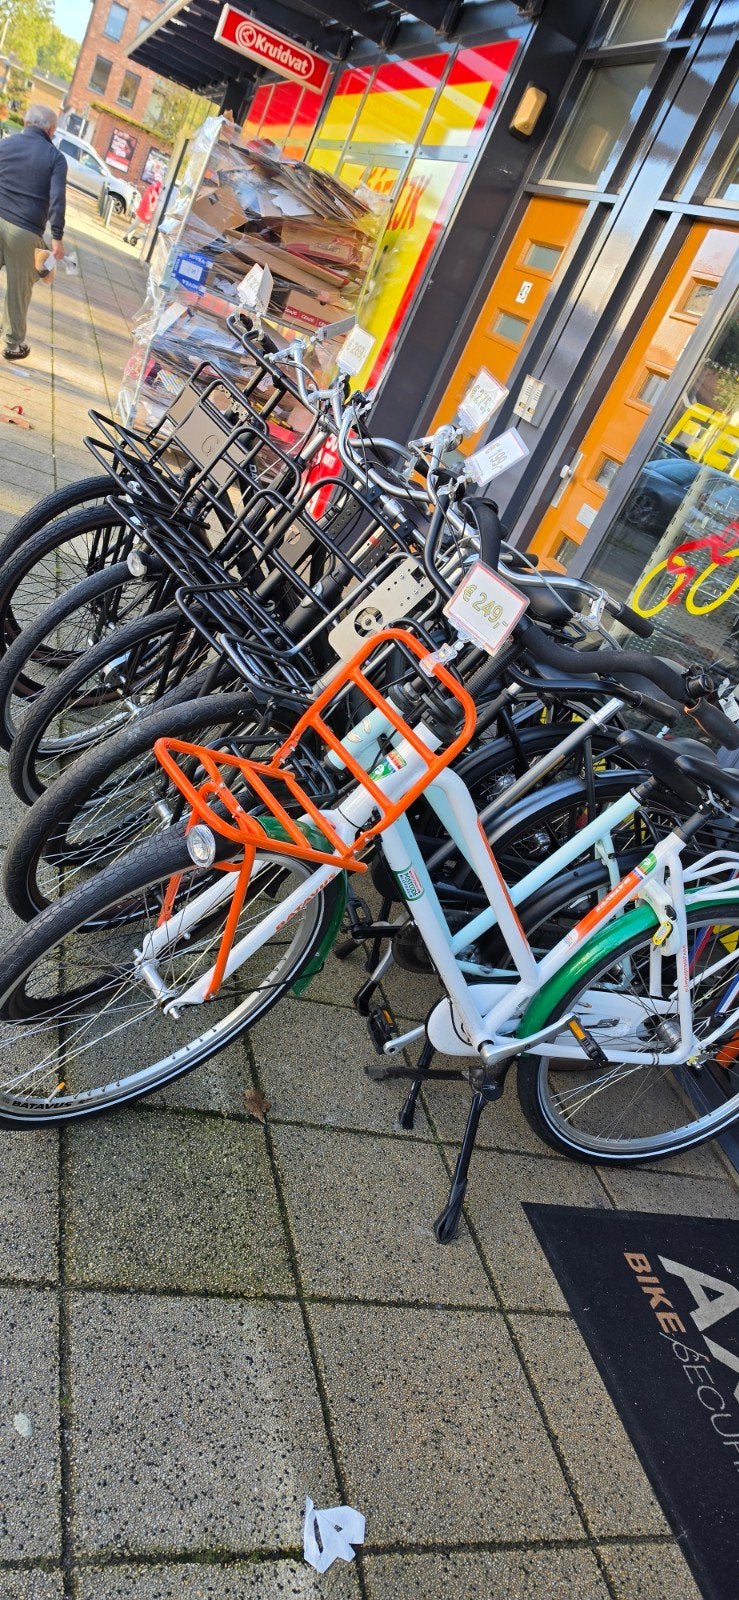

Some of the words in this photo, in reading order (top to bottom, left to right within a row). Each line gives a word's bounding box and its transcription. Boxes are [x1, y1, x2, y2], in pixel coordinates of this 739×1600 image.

[254, 33, 309, 75] Kruidvat
[462, 584, 477, 602] €
[472, 591, 509, 629] 249,-
[275, 872, 337, 933] BATAVUS
[11, 1100, 74, 1110] BATAVUS
[623, 1252, 687, 1334] BIKE
